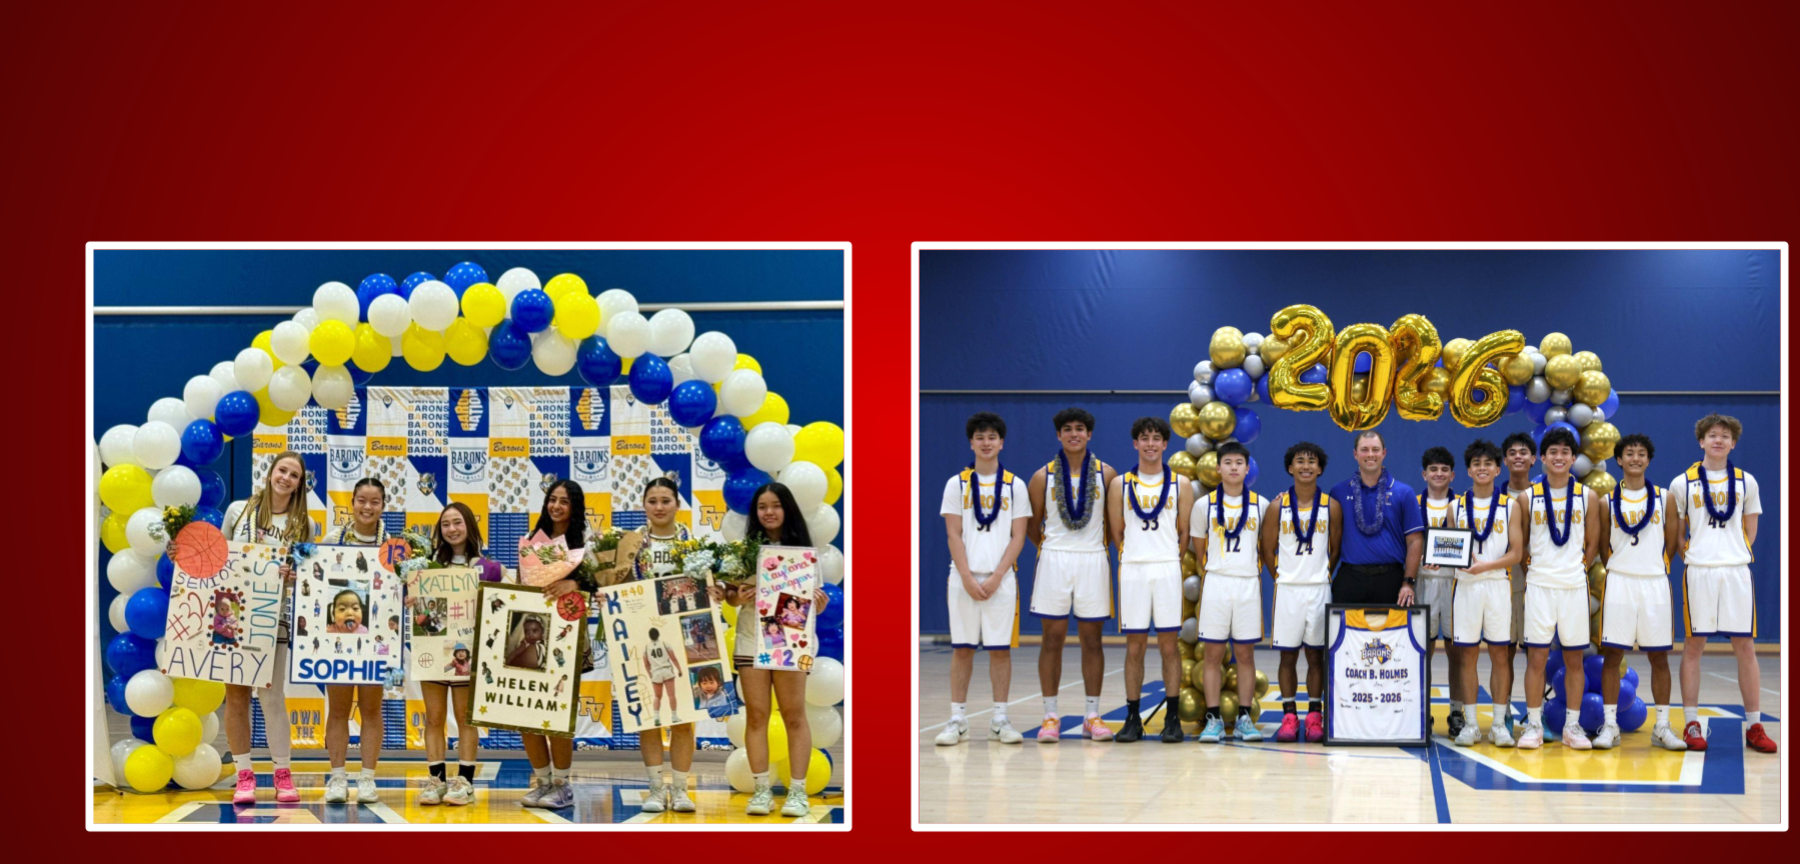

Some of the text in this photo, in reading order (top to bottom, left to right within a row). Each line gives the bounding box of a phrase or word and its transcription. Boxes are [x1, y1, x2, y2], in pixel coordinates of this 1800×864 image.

[1269, 304, 1525, 432] 2026
[372, 440, 402, 451] Barons
[493, 442, 524, 452] Barons
[616, 440, 646, 451] Barons
[330, 448, 364, 464] BARONS
[452, 450, 487, 465] BARONS
[573, 450, 609, 464] BARONS
[699, 506, 725, 532] FV
[1226, 536, 1241, 552] 12
[1630, 530, 1640, 546] 3
[386, 544, 406, 565] 13
[1295, 538, 1314, 556] 24
[419, 572, 479, 596] KAILYN
[620, 584, 644, 598] #40
[249, 560, 280, 648] JONES
[450, 600, 476, 620] #11
[166, 592, 210, 641] #32
[605, 590, 642, 726] KAILEY
[650, 648, 664, 659] 40
[758, 648, 794, 666] #12
[1361, 648, 1392, 660] BARONS
[168, 646, 268, 685] AVERY
[298, 658, 387, 681] SOPHIE
[1346, 667, 1408, 680] COACH B. HOLMES
[496, 676, 549, 693] HELEN
[485, 692, 558, 712] WILLIAM
[1352, 692, 1373, 703] 2025
[1380, 692, 1402, 703] 2026
[578, 696, 604, 722] FV
[290, 710, 320, 726] OWN
[296, 726, 316, 739] THE
